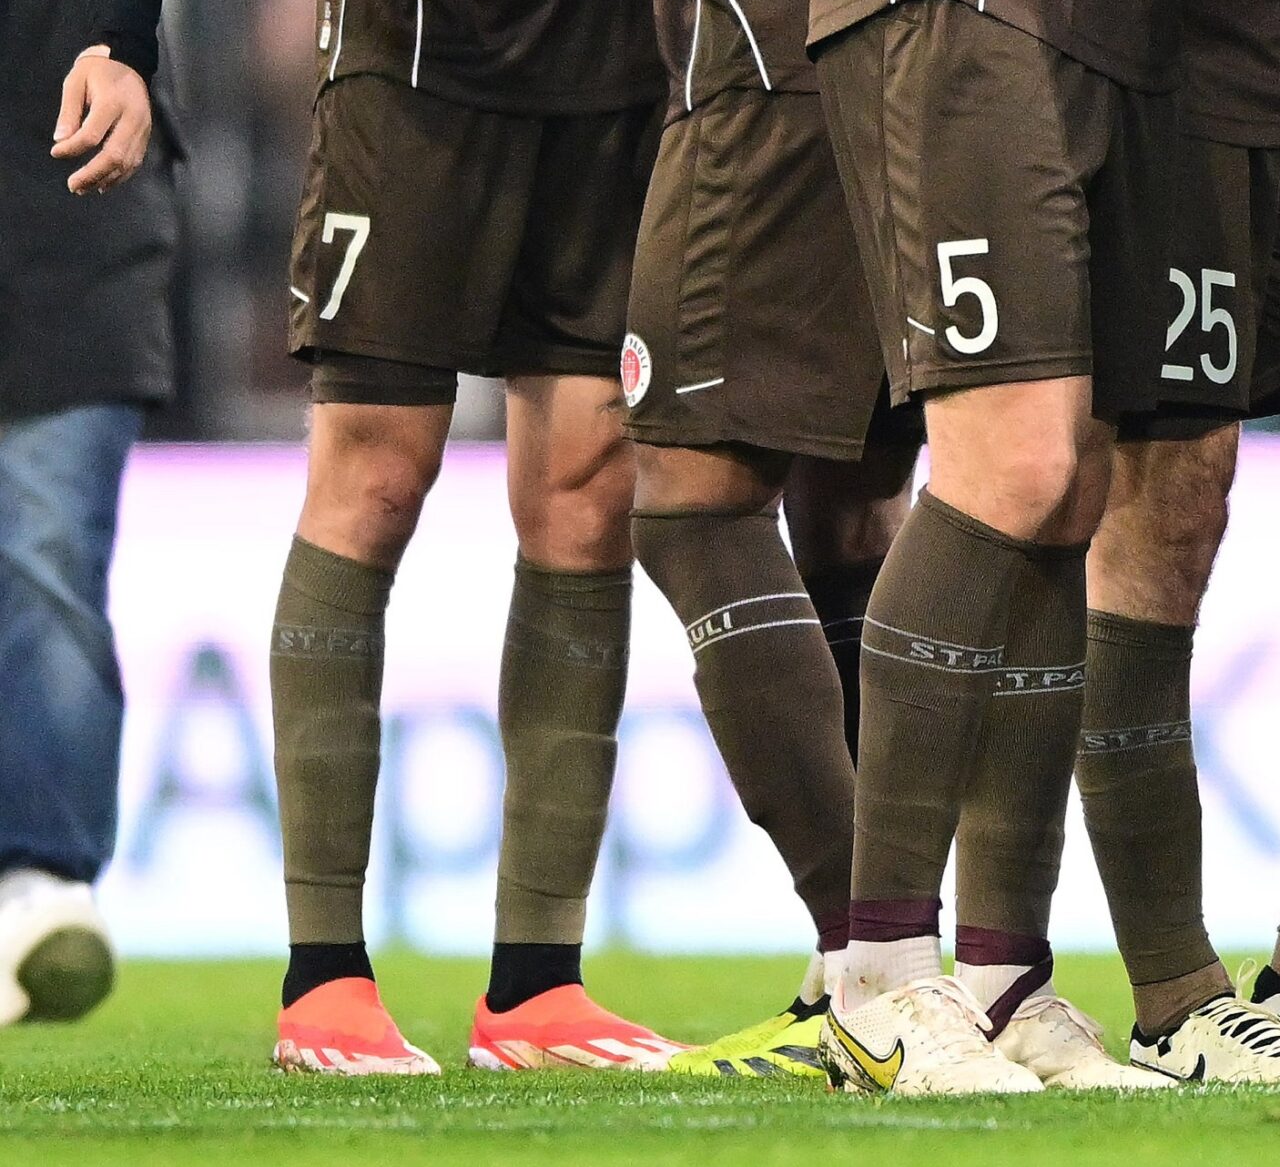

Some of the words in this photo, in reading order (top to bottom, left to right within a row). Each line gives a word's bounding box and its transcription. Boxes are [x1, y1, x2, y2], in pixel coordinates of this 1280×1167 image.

[320, 213, 370, 321] 7
[936, 238, 999, 355] 5
[1161, 267, 1238, 384] 25
